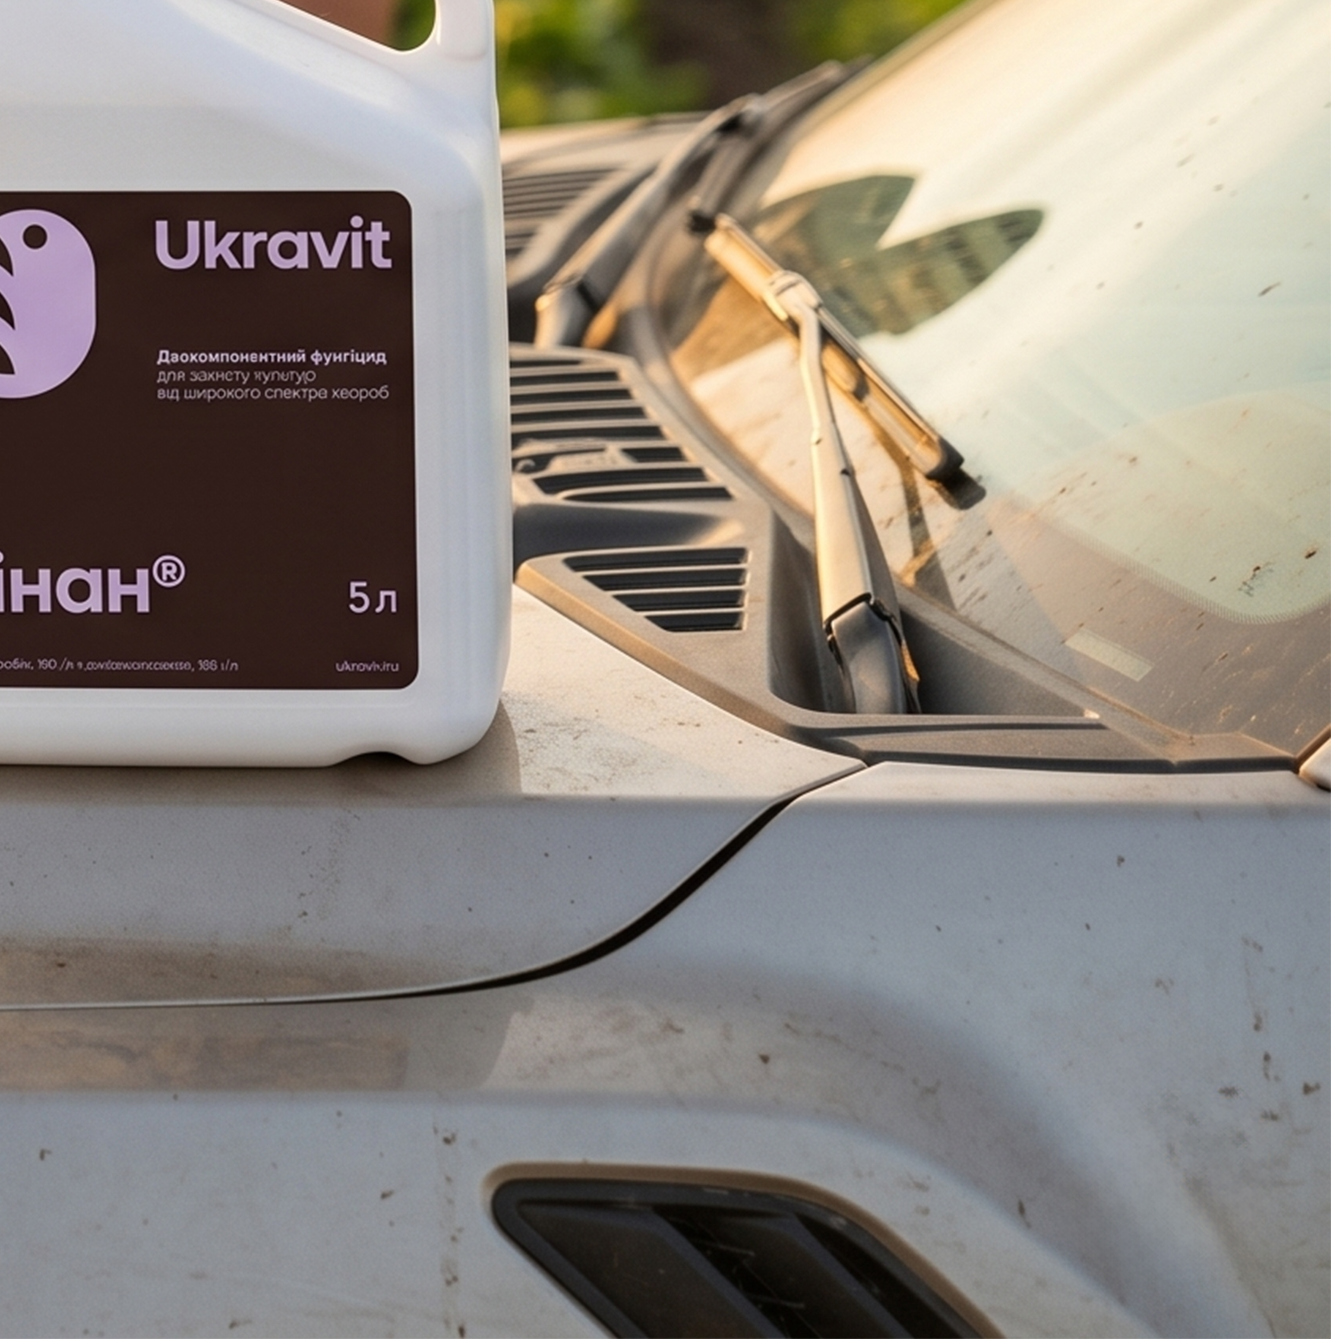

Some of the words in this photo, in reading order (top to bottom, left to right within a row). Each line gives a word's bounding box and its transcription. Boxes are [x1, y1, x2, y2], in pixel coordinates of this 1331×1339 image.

[154, 215, 393, 270] Ukravit
[309, 348, 388, 367] фунгіцид
[183, 387, 262, 403] широкого
[348, 581, 371, 614] 5
